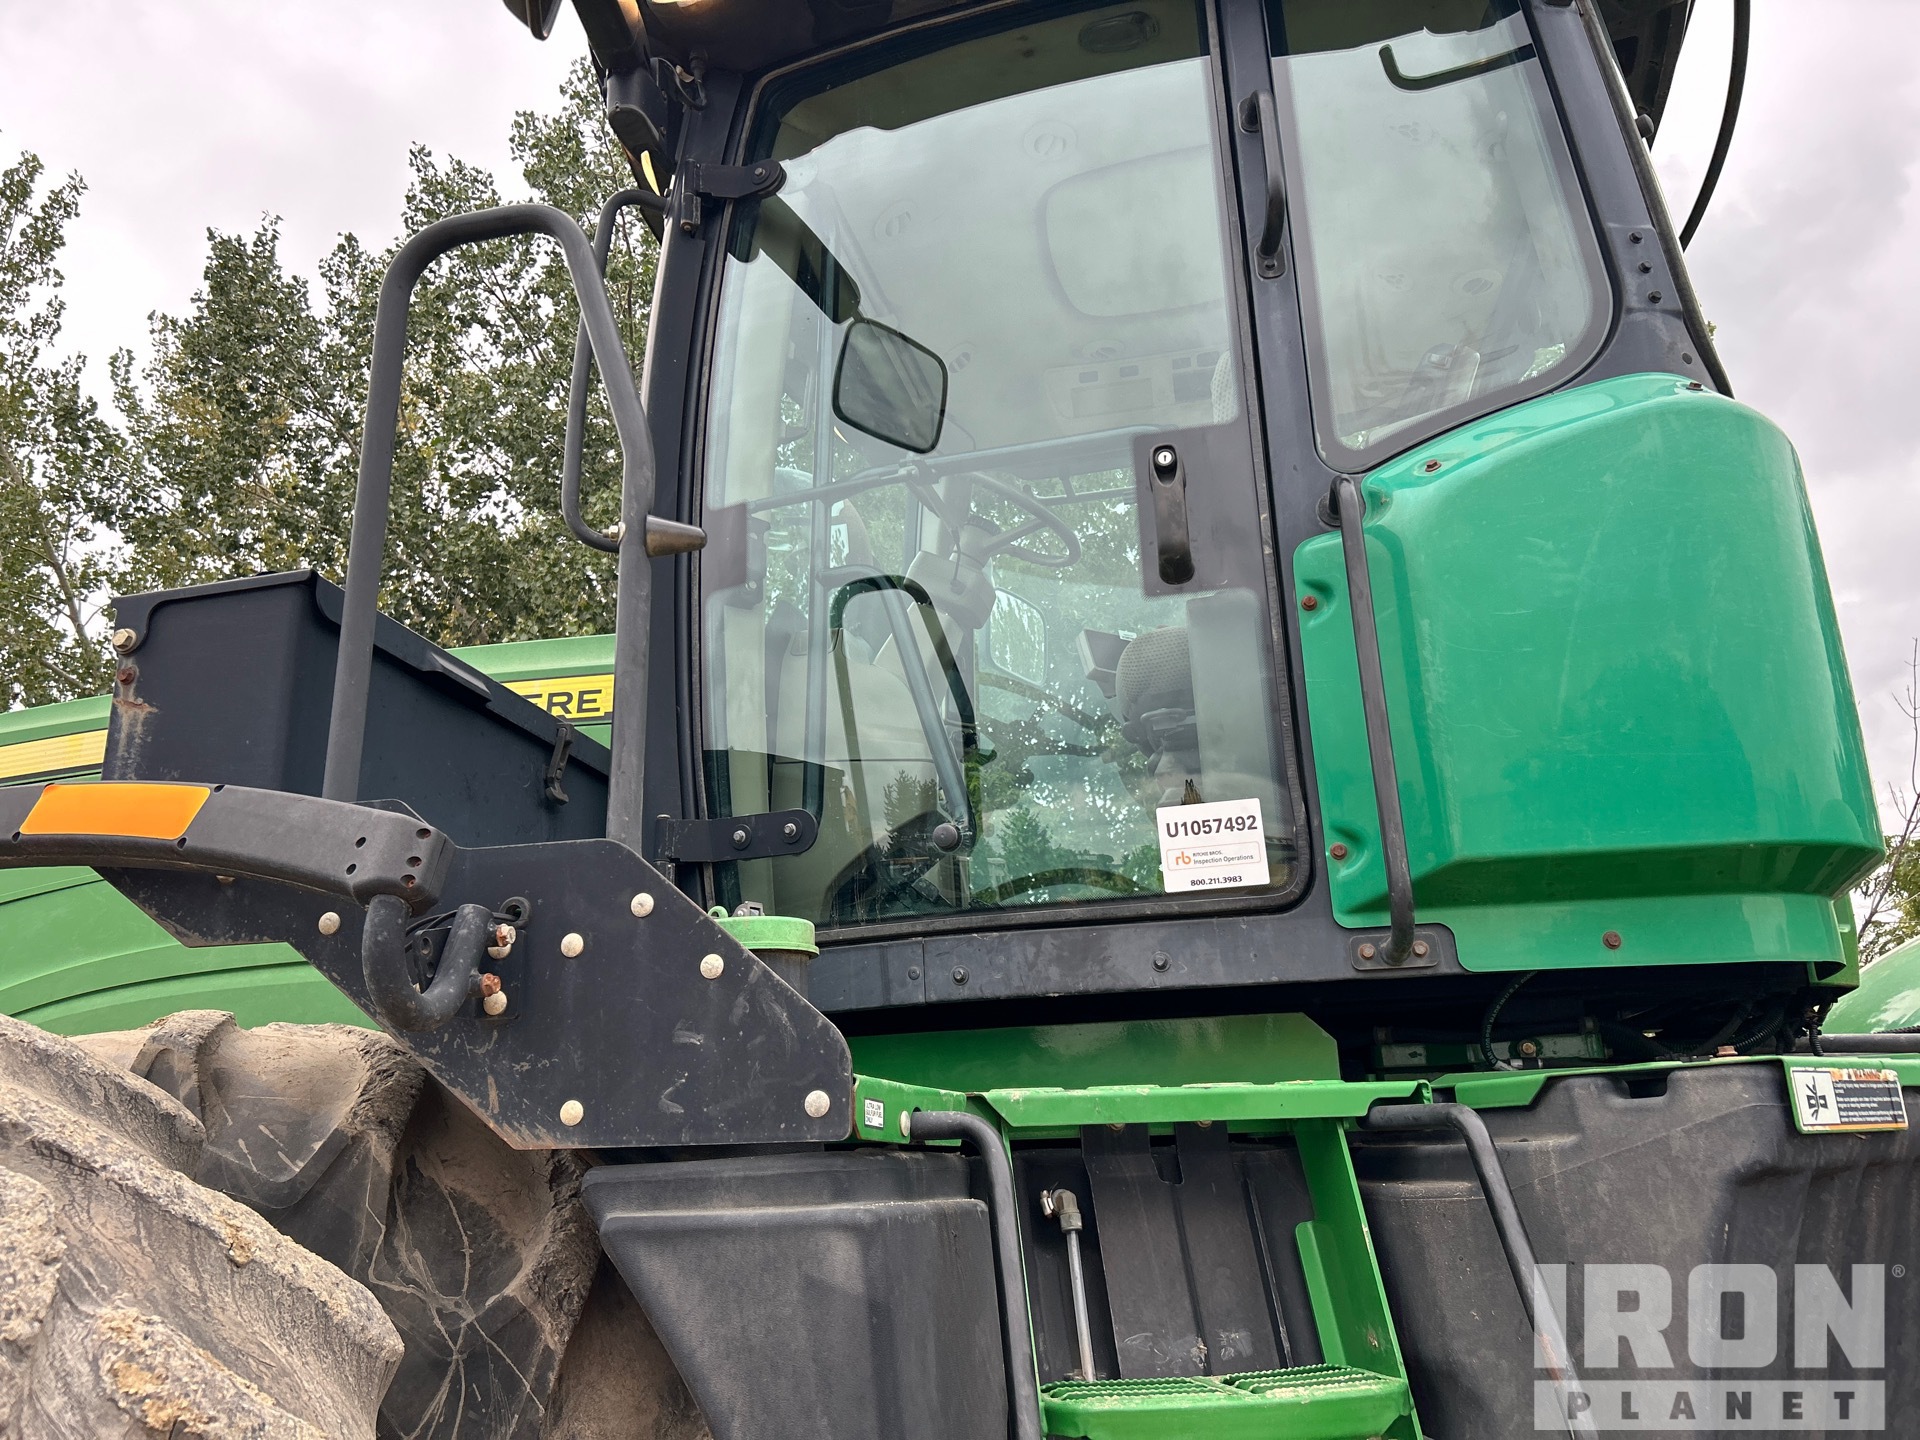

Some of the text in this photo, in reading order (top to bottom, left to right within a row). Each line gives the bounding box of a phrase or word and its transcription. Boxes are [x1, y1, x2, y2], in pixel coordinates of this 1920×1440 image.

[1165, 814, 1258, 838] U1057492
[1175, 851, 1192, 865] rb
[1193, 854, 1254, 865] Inspection Operations
[1190, 875, 1243, 887] 800.211.3983
